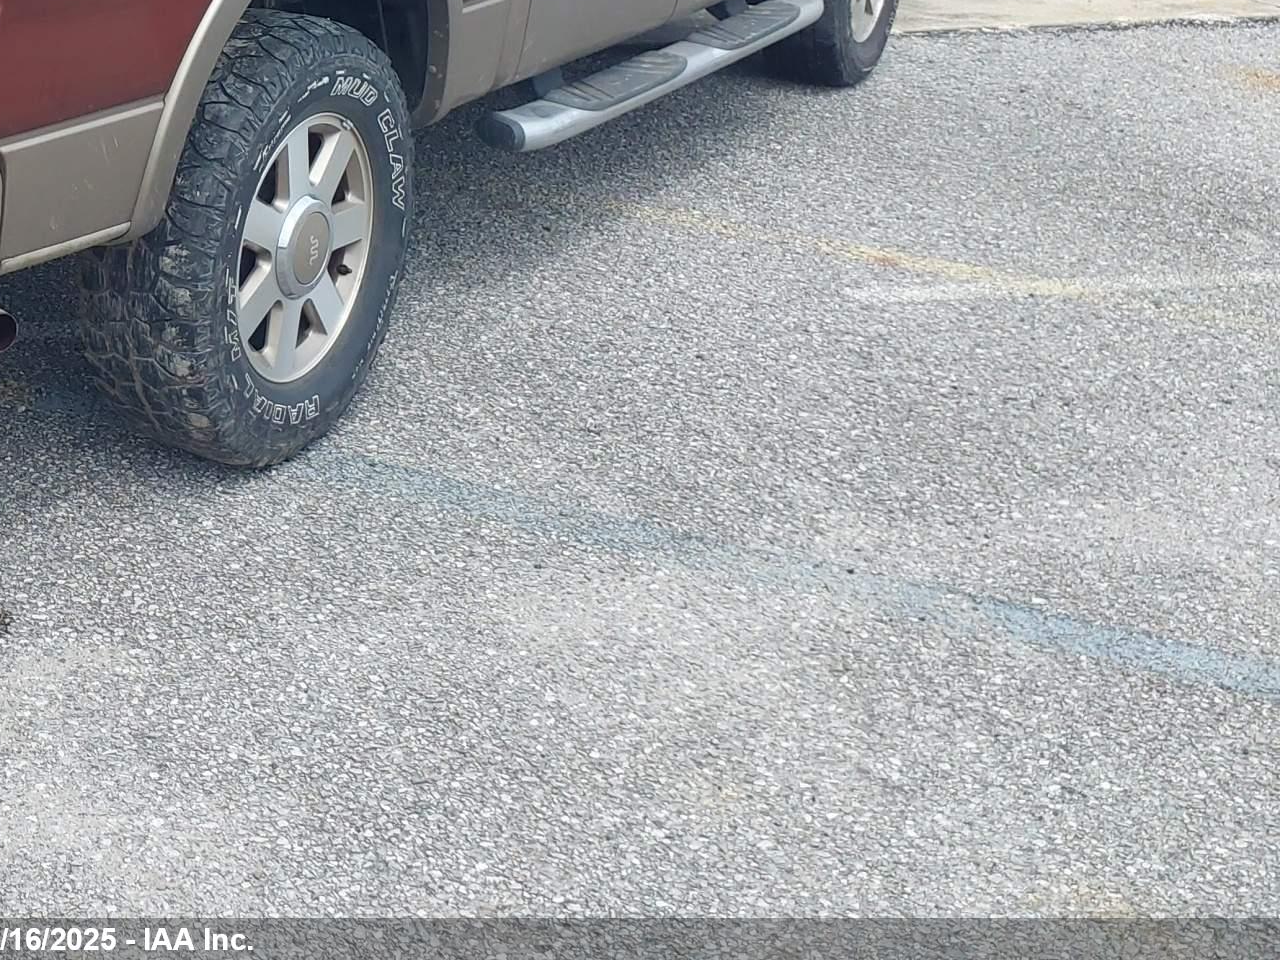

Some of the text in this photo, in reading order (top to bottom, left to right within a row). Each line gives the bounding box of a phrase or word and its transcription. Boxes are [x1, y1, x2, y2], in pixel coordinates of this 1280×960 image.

[330, 76, 406, 211] MUD CLAW
[245, 373, 321, 425] RADIAL
